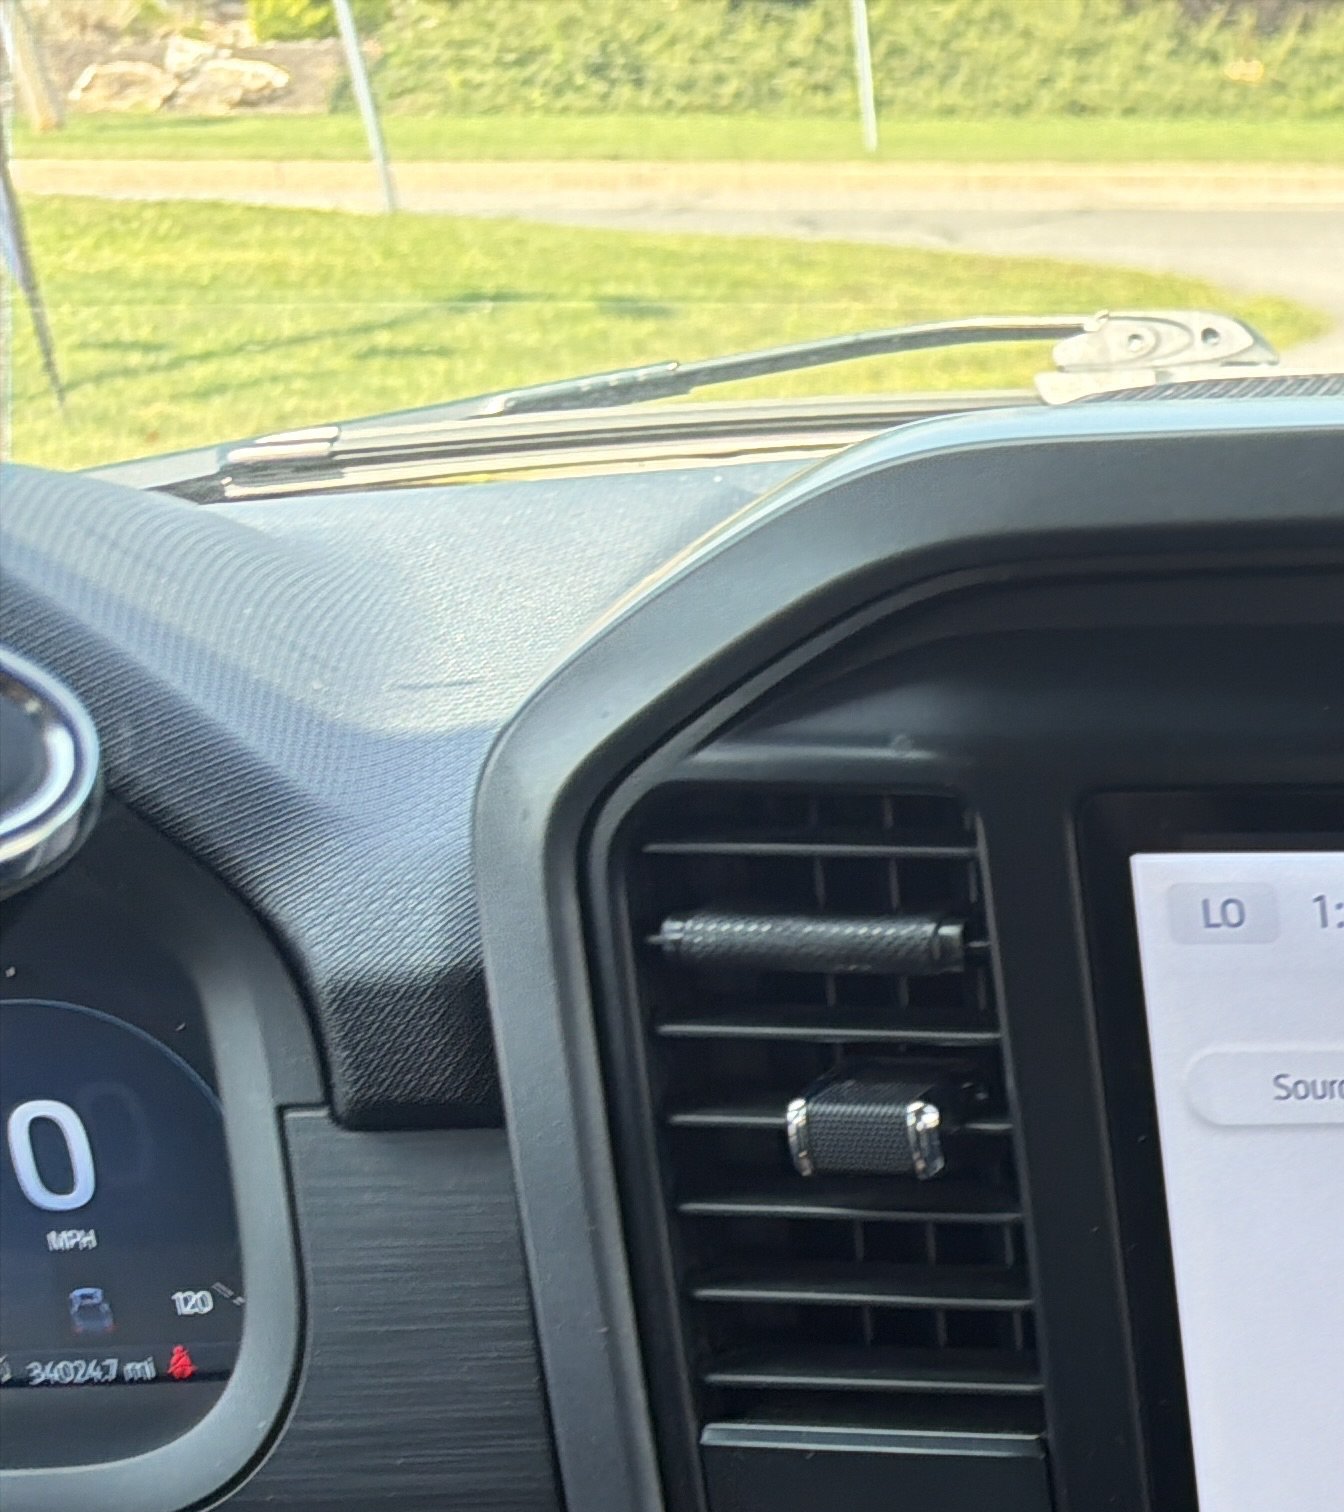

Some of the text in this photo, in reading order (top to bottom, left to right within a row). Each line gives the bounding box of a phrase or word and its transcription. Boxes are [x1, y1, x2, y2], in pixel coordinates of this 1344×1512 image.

[1202, 899, 1245, 928] LO
[8, 1100, 94, 1210] 0
[47, 1229, 97, 1250] MPH
[172, 1291, 213, 1315] 120
[123, 1357, 158, 1383] mi
